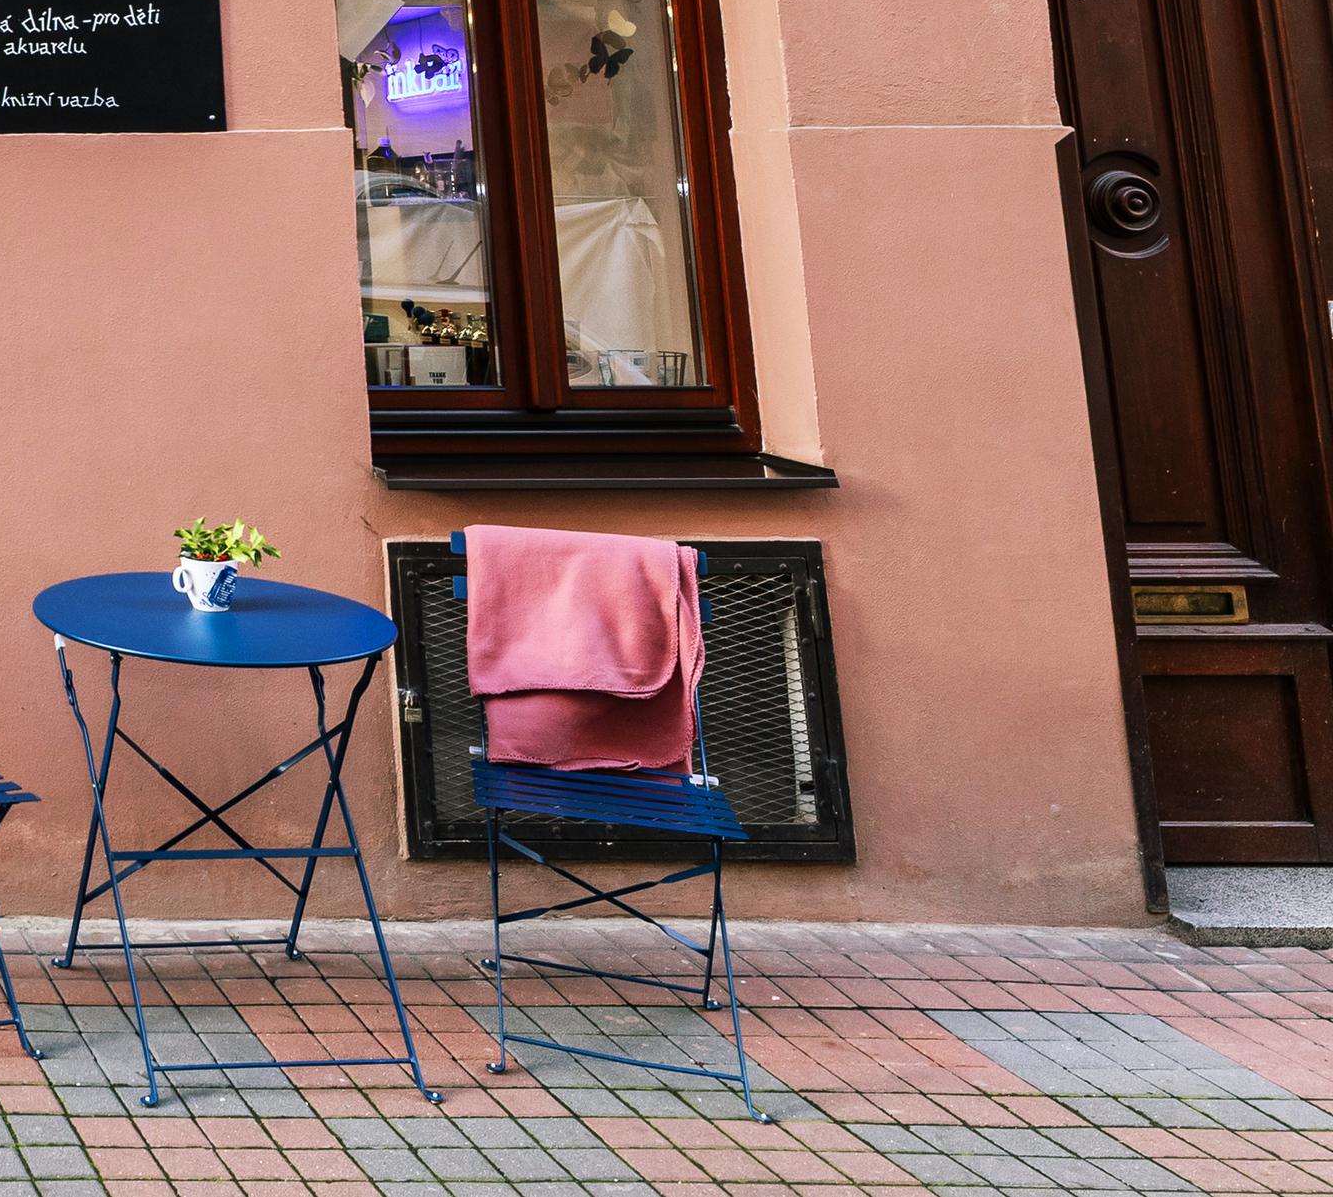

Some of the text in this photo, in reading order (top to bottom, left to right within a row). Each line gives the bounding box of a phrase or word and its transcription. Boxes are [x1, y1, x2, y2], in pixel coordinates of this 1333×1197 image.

[21, 7, 79, 34] dílna
[122, 3, 161, 27] děti
[1, 86, 55, 108] knižní
